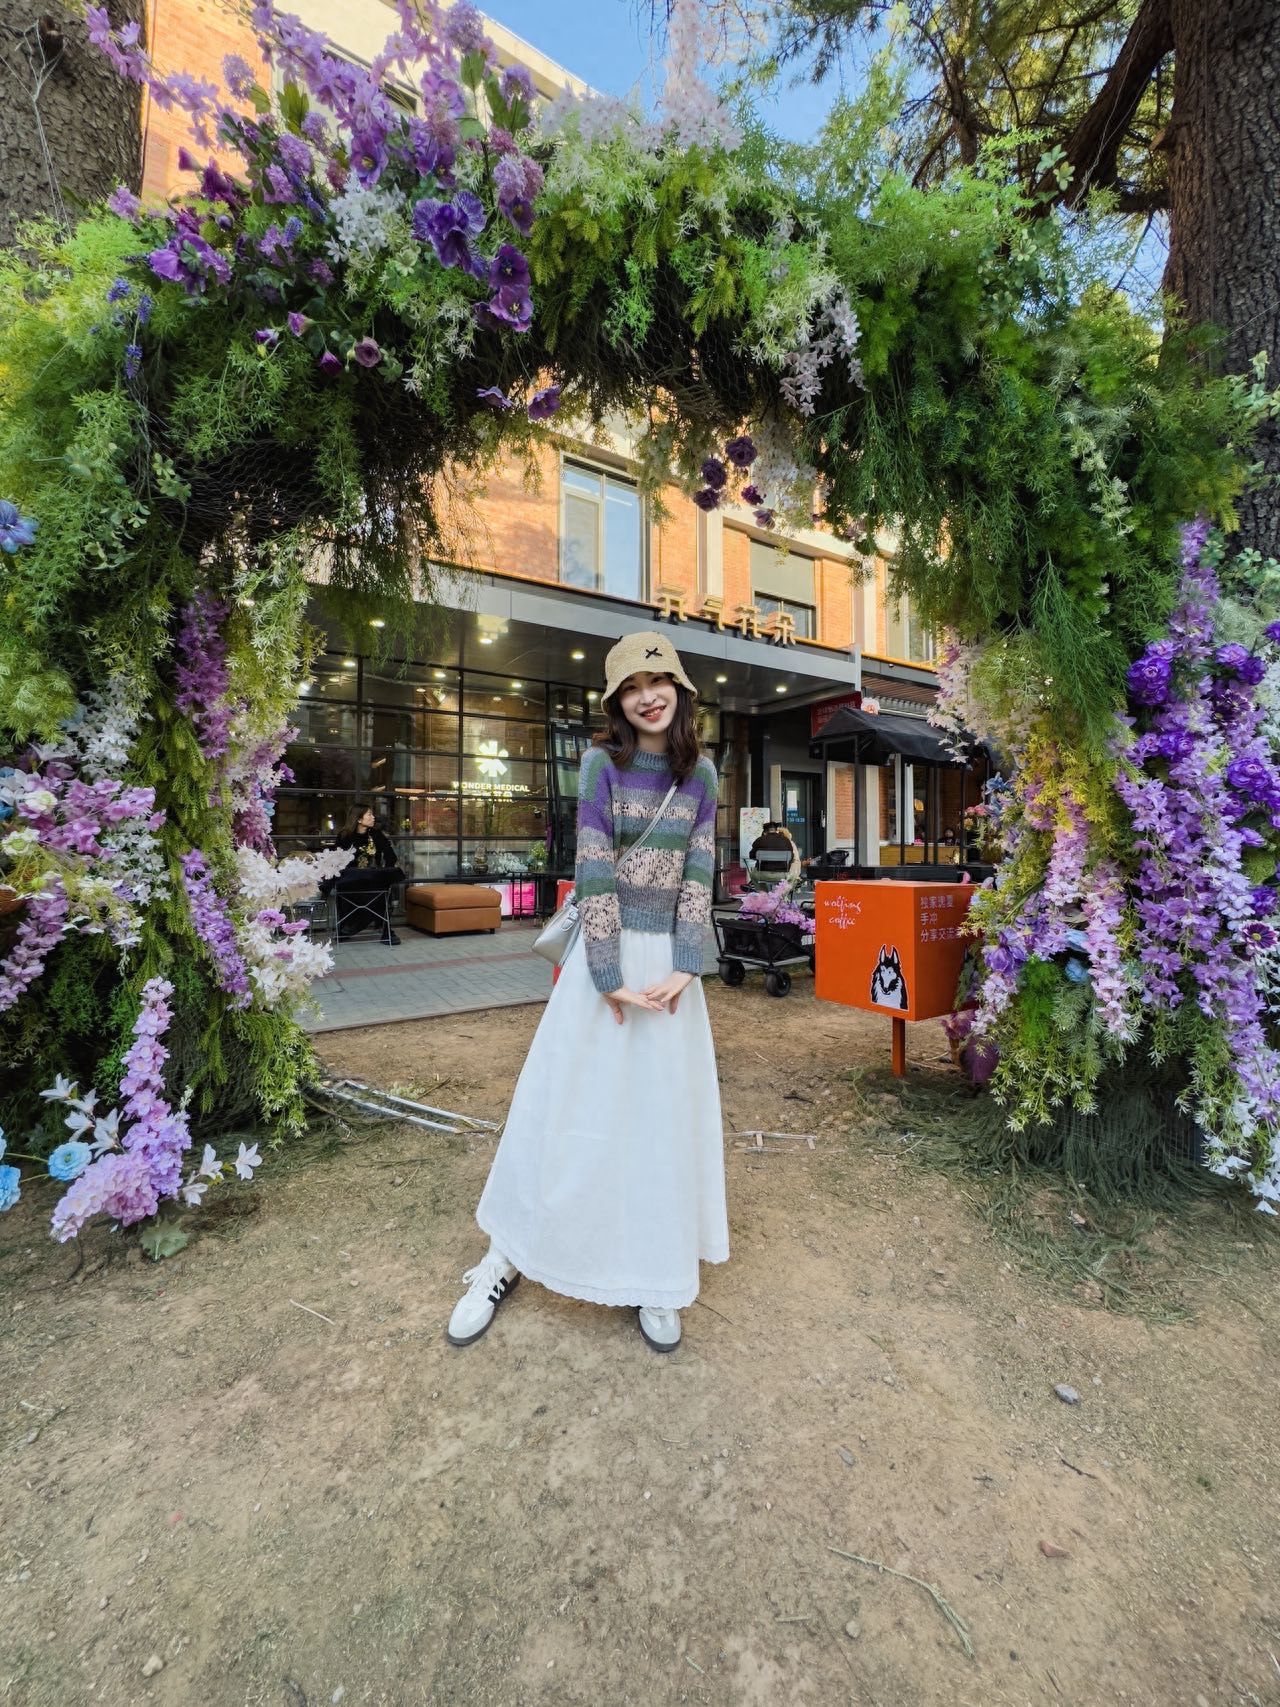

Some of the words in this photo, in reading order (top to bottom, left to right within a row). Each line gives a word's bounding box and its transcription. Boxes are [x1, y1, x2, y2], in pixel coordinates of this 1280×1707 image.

[452, 781, 492, 790] WONDER
[493, 784, 530, 792] MEDICAL
[920, 912, 938, 926] 手冲
